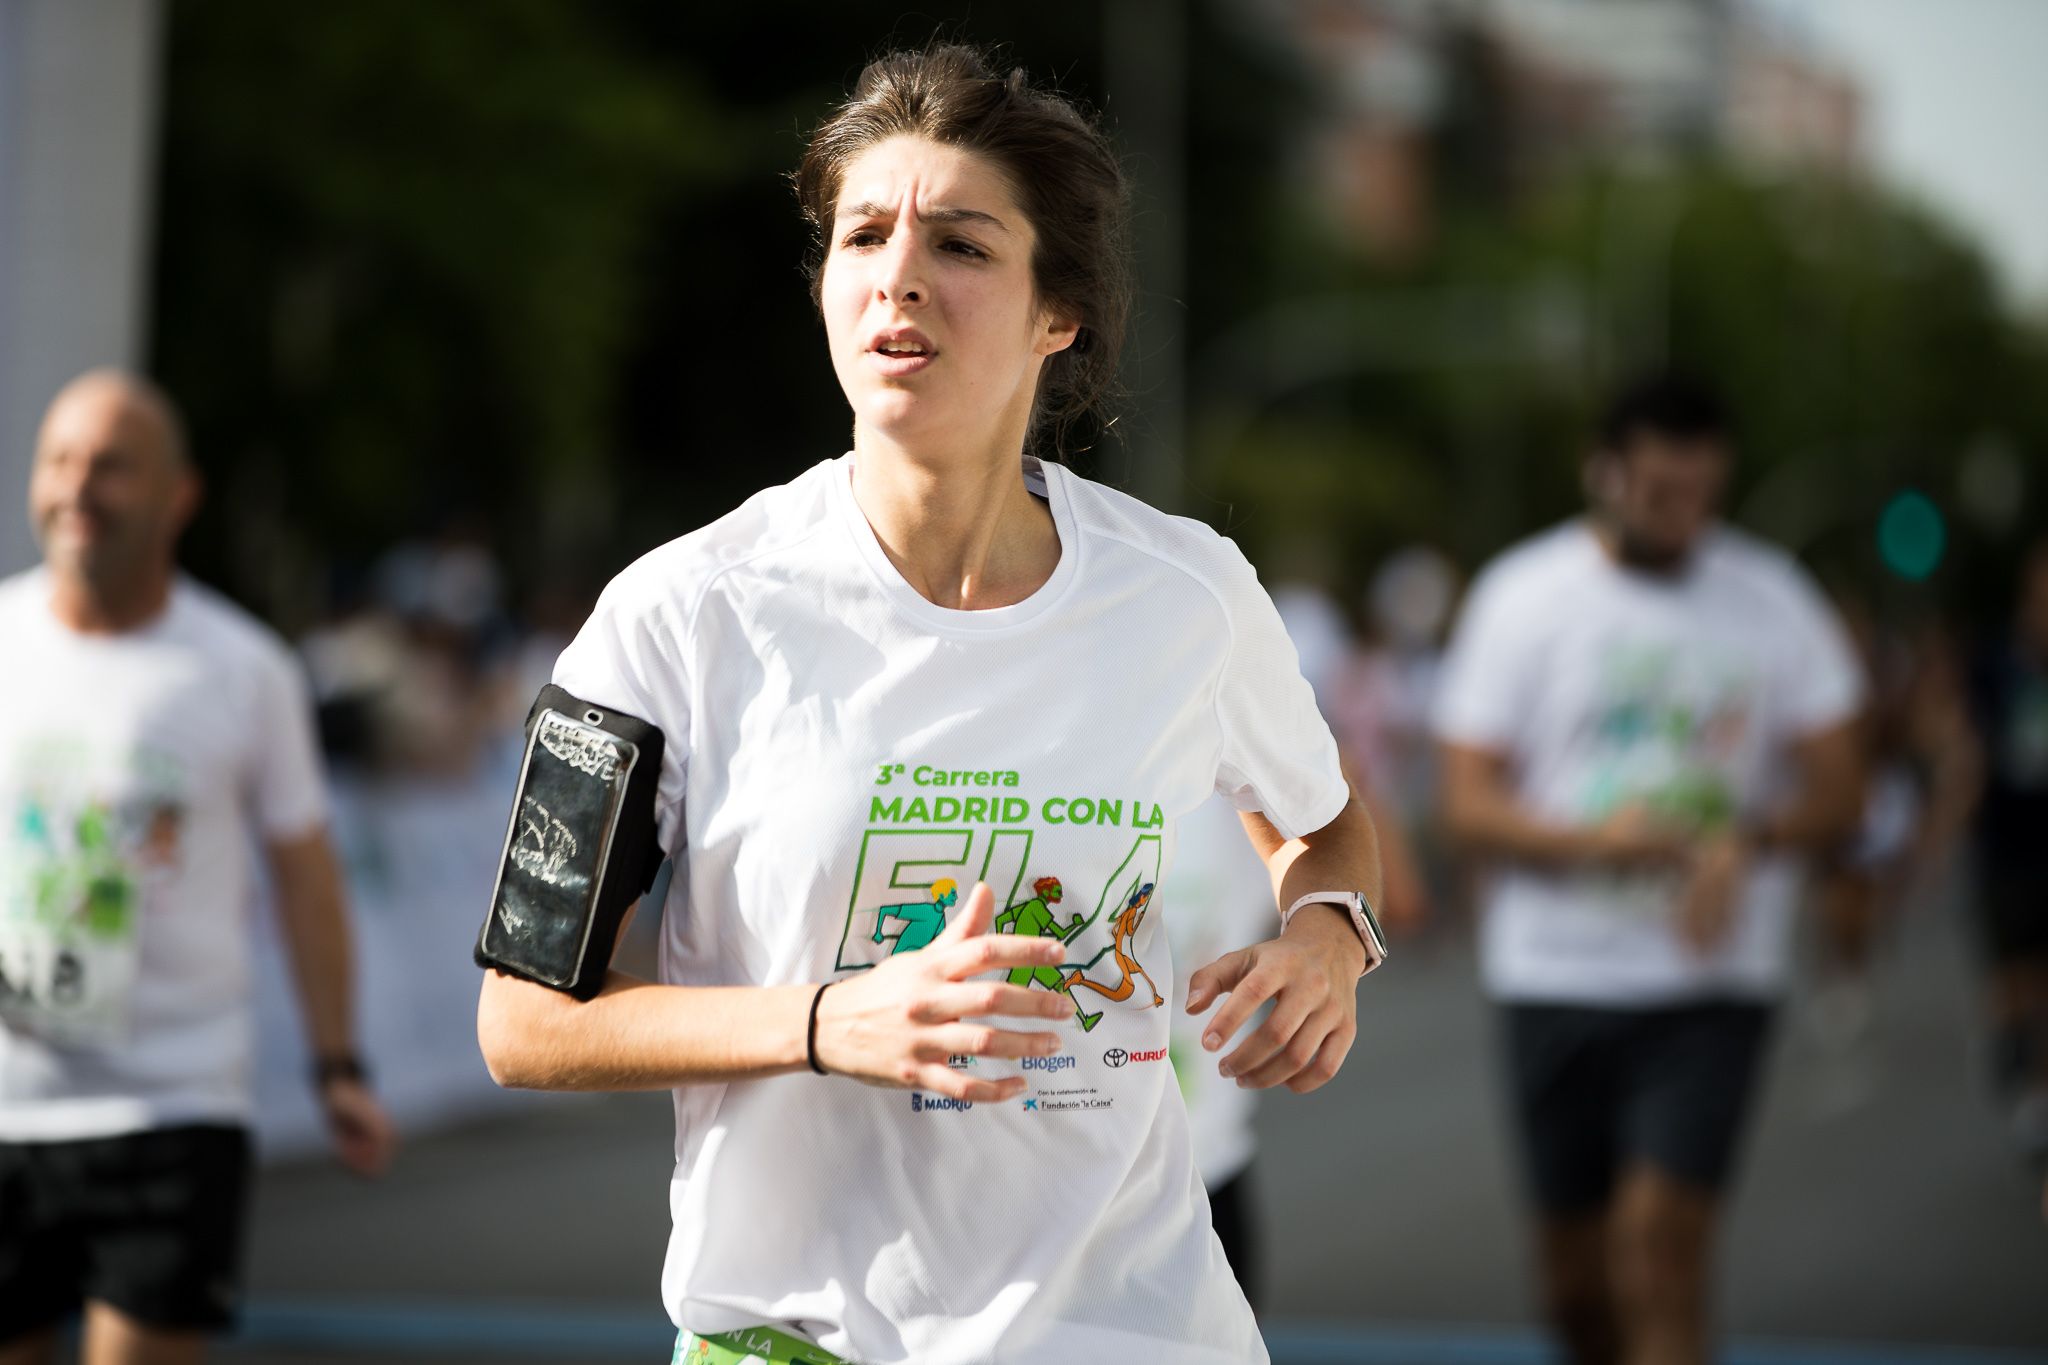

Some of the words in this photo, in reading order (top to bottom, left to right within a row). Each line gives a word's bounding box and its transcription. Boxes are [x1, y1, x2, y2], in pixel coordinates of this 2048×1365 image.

[913, 765, 1020, 787] Carrera
[869, 796, 1030, 823] MADRID
[1042, 797, 1123, 826] CON
[1132, 801, 1164, 830] LA
[1022, 1055, 1076, 1073] Biogen
[1041, 1100, 1080, 1109] Fundación
[746, 1332, 772, 1356] LA
